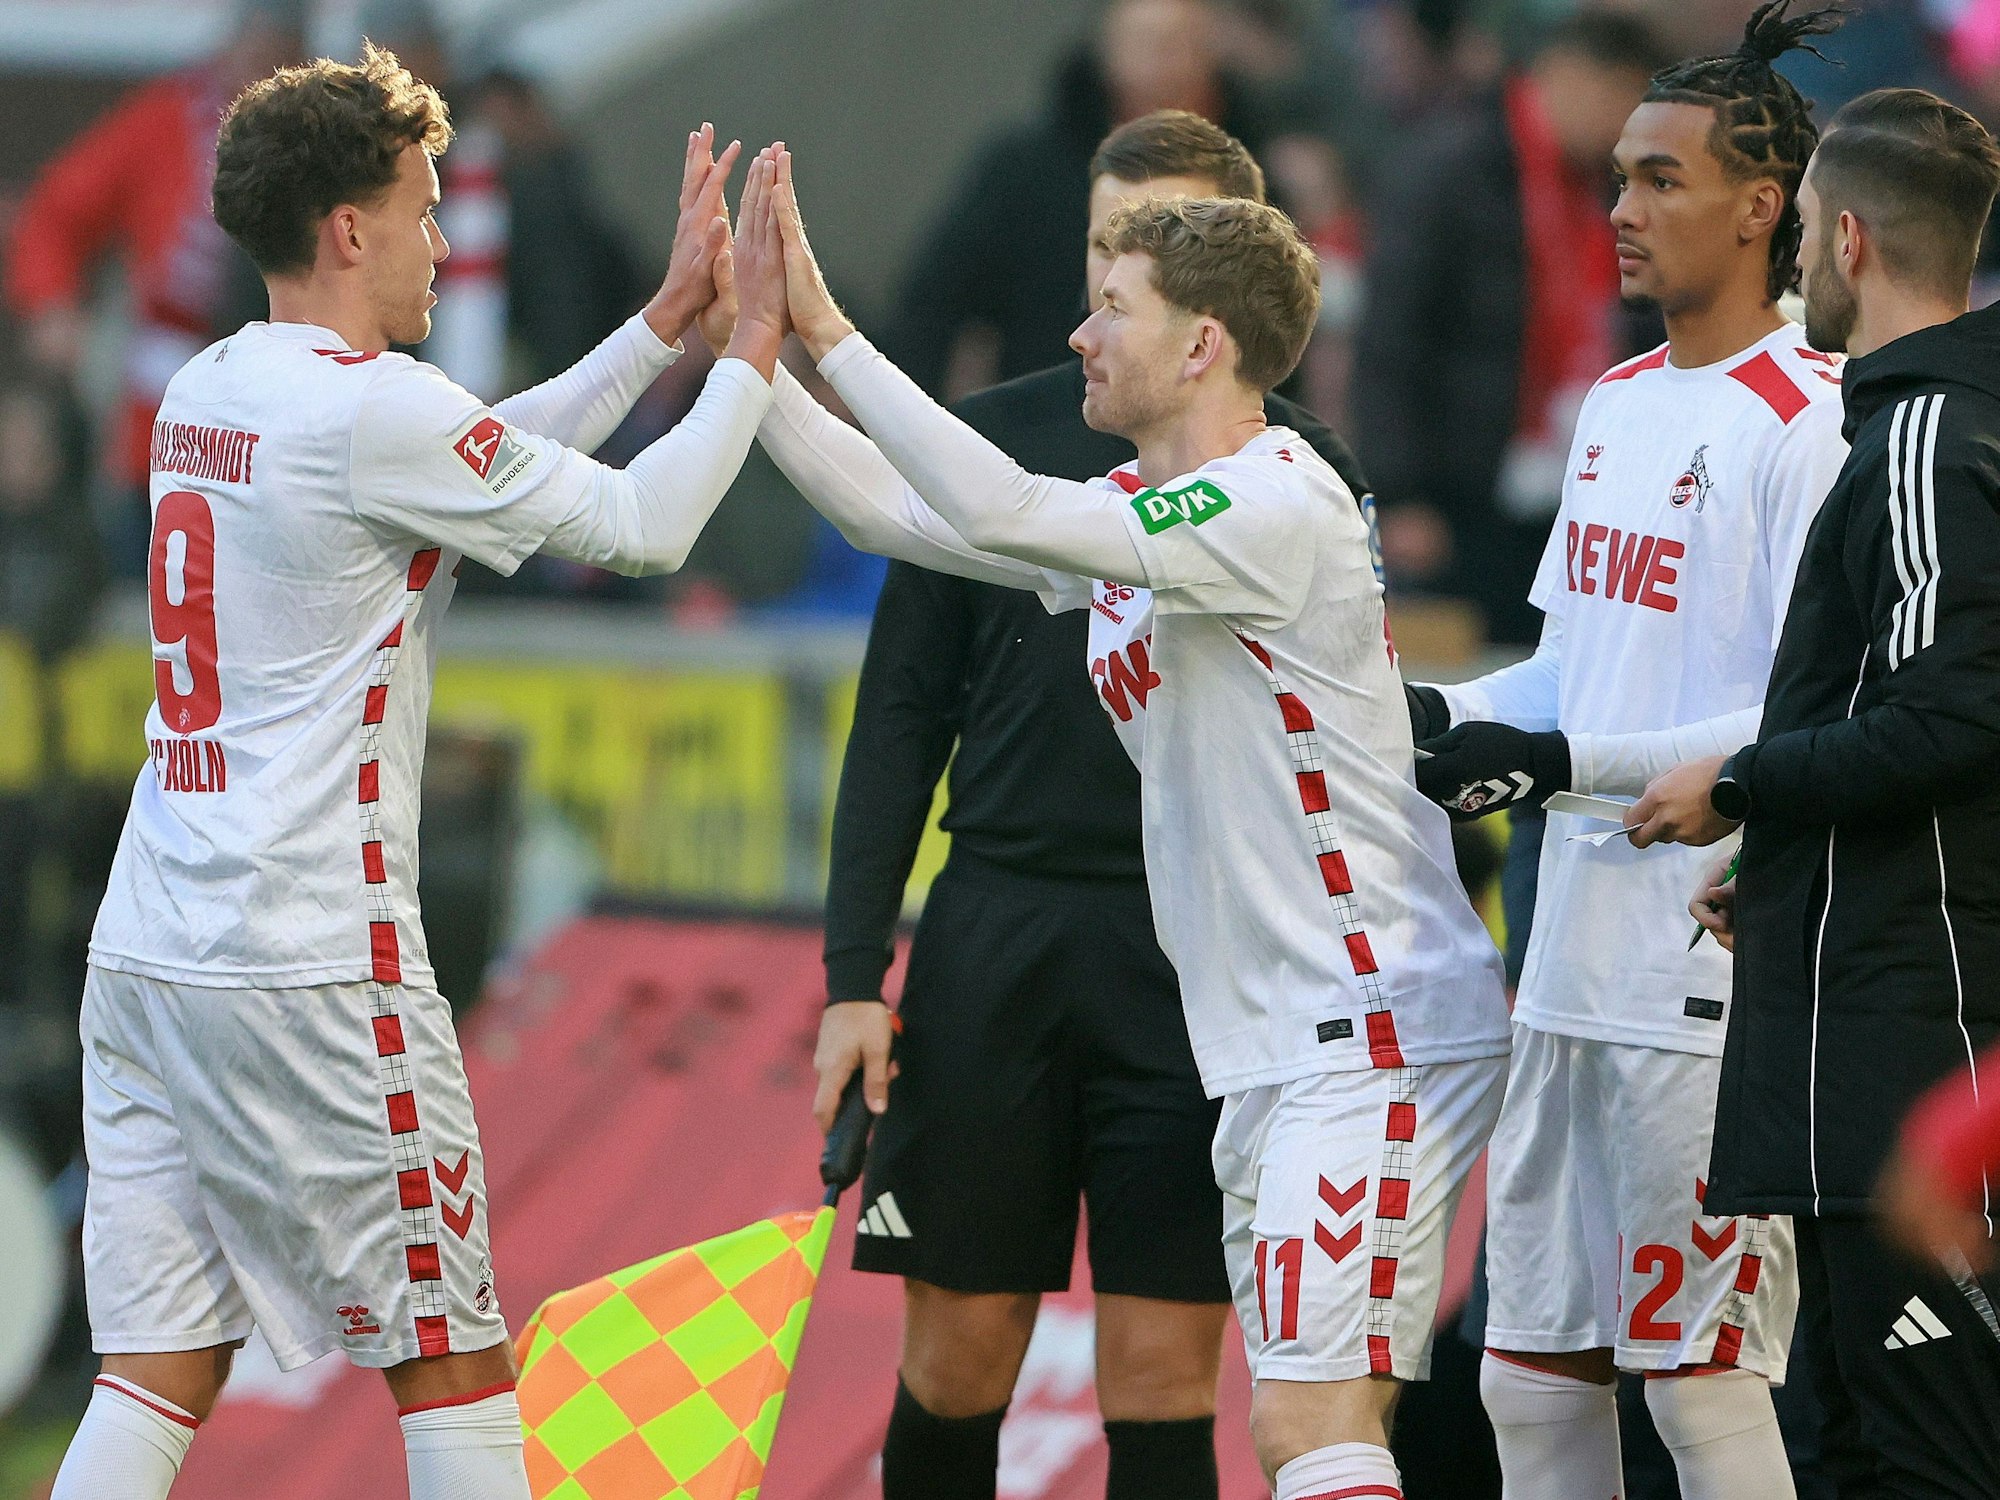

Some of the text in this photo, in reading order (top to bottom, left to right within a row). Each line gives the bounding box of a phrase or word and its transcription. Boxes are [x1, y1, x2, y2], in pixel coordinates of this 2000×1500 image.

[492, 451, 536, 494] BUNDESLIGA
[149, 490, 222, 734] 9
[1091, 599, 1124, 625] ummel
[1567, 520, 1685, 613] REWE
[151, 732, 226, 793] C KÖLN
[1254, 1238, 1304, 1342] 11
[1618, 1232, 1683, 1340] 2
